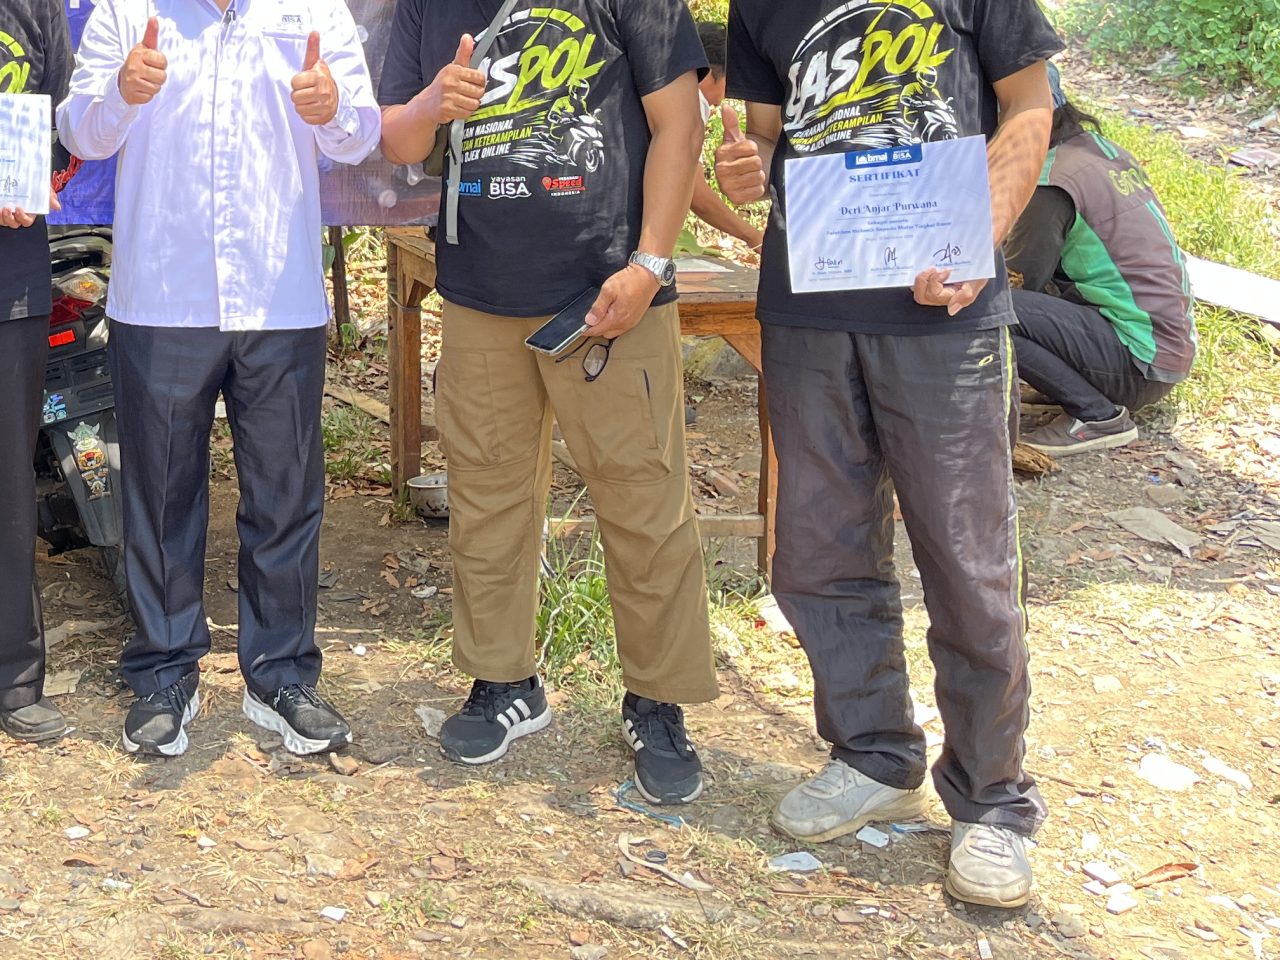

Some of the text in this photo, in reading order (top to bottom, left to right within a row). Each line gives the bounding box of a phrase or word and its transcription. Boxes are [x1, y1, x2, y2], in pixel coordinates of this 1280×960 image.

[475, 119, 514, 136] NASIONAL
[474, 126, 533, 148] KETERAMPILAN
[481, 143, 511, 158] ONLINE
[491, 176, 526, 184] yayasan
[849, 168, 920, 183] SERTIFIKAT
[489, 182, 530, 196] BISA
[893, 200, 938, 212] Purwana
